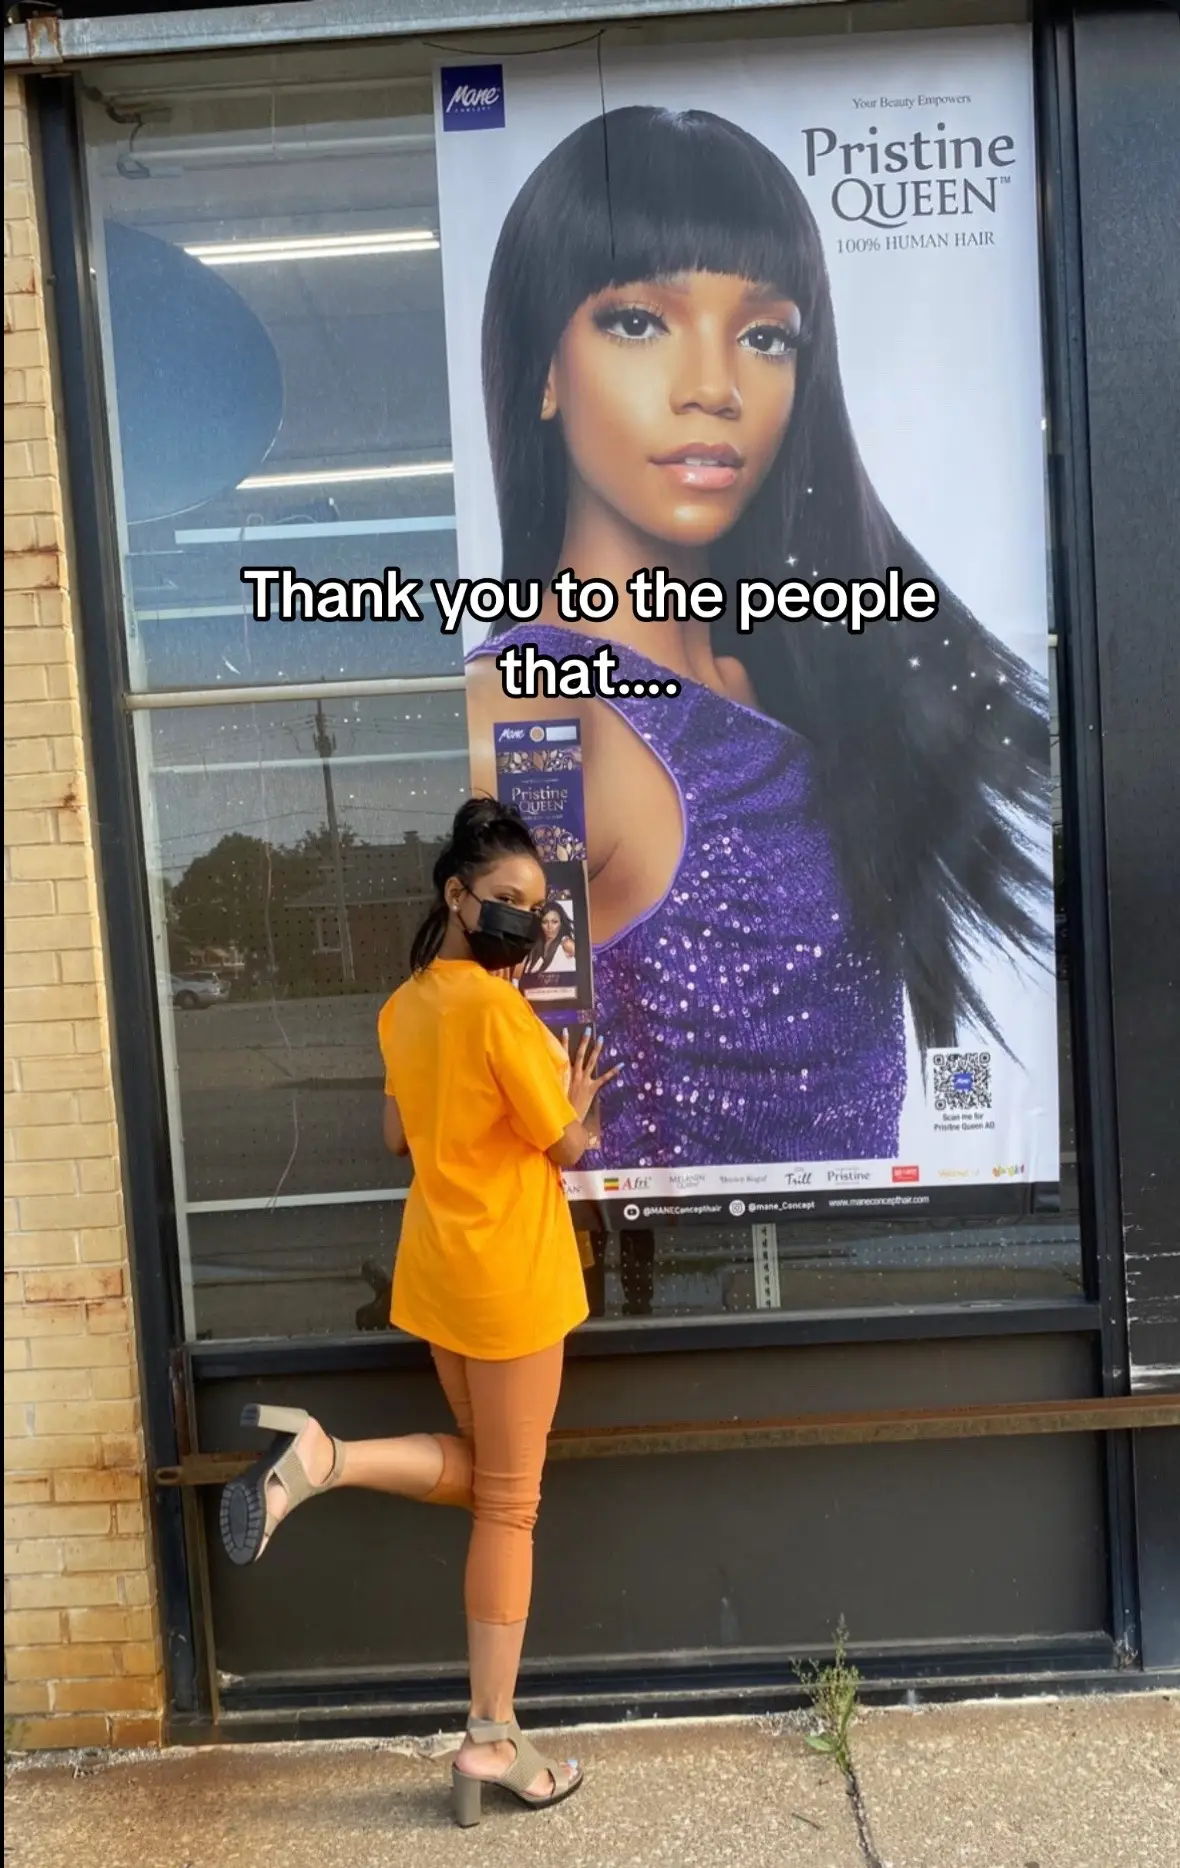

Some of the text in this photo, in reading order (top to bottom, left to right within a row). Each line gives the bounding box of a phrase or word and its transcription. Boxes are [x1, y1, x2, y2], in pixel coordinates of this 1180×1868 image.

[446, 85, 499, 113] Mane
[852, 93, 972, 109] Your Beauty Empowers
[801, 121, 1017, 176] Pristine
[837, 231, 995, 254] 100% HUMAN HAIR
[512, 785, 568, 801] Pristine
[785, 1172, 813, 1185] Trill
[827, 1169, 871, 1181] Pristine
[748, 1200, 815, 1213] @mane_Concept
[828, 1195, 930, 1207] www.maneconcepthair.com
